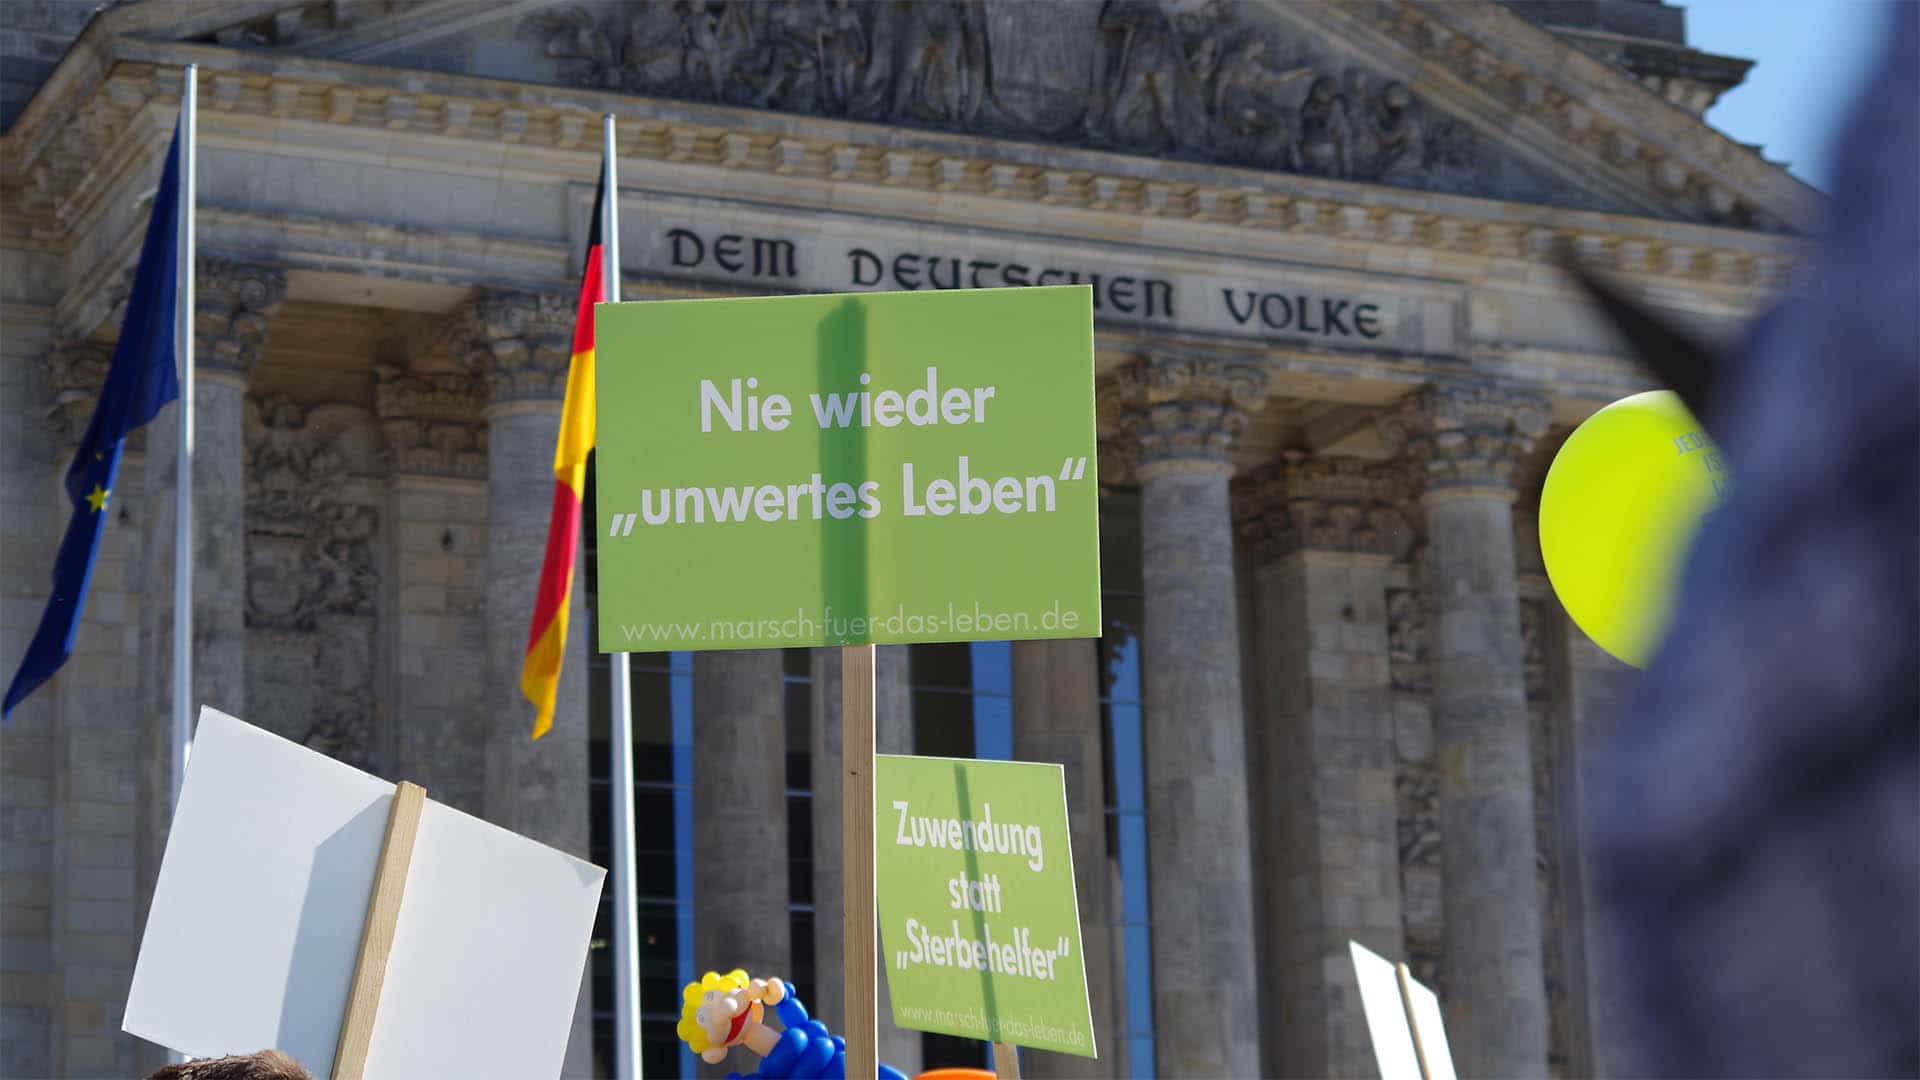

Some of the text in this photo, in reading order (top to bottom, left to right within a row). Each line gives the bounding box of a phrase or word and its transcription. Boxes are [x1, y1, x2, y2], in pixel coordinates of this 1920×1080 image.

[666, 228, 797, 277] DEM
[1221, 288, 1382, 339] VOLKE
[700, 366, 995, 433] Nie wieder
[609, 456, 1087, 537] „unwertes Leben“
[621, 600, 1080, 641] www.marsch-fuer-das-leben.de
[893, 800, 1044, 872] Zuwendung
[948, 871, 1002, 913] statt
[896, 918, 1070, 981] „Sterbehelfer“
